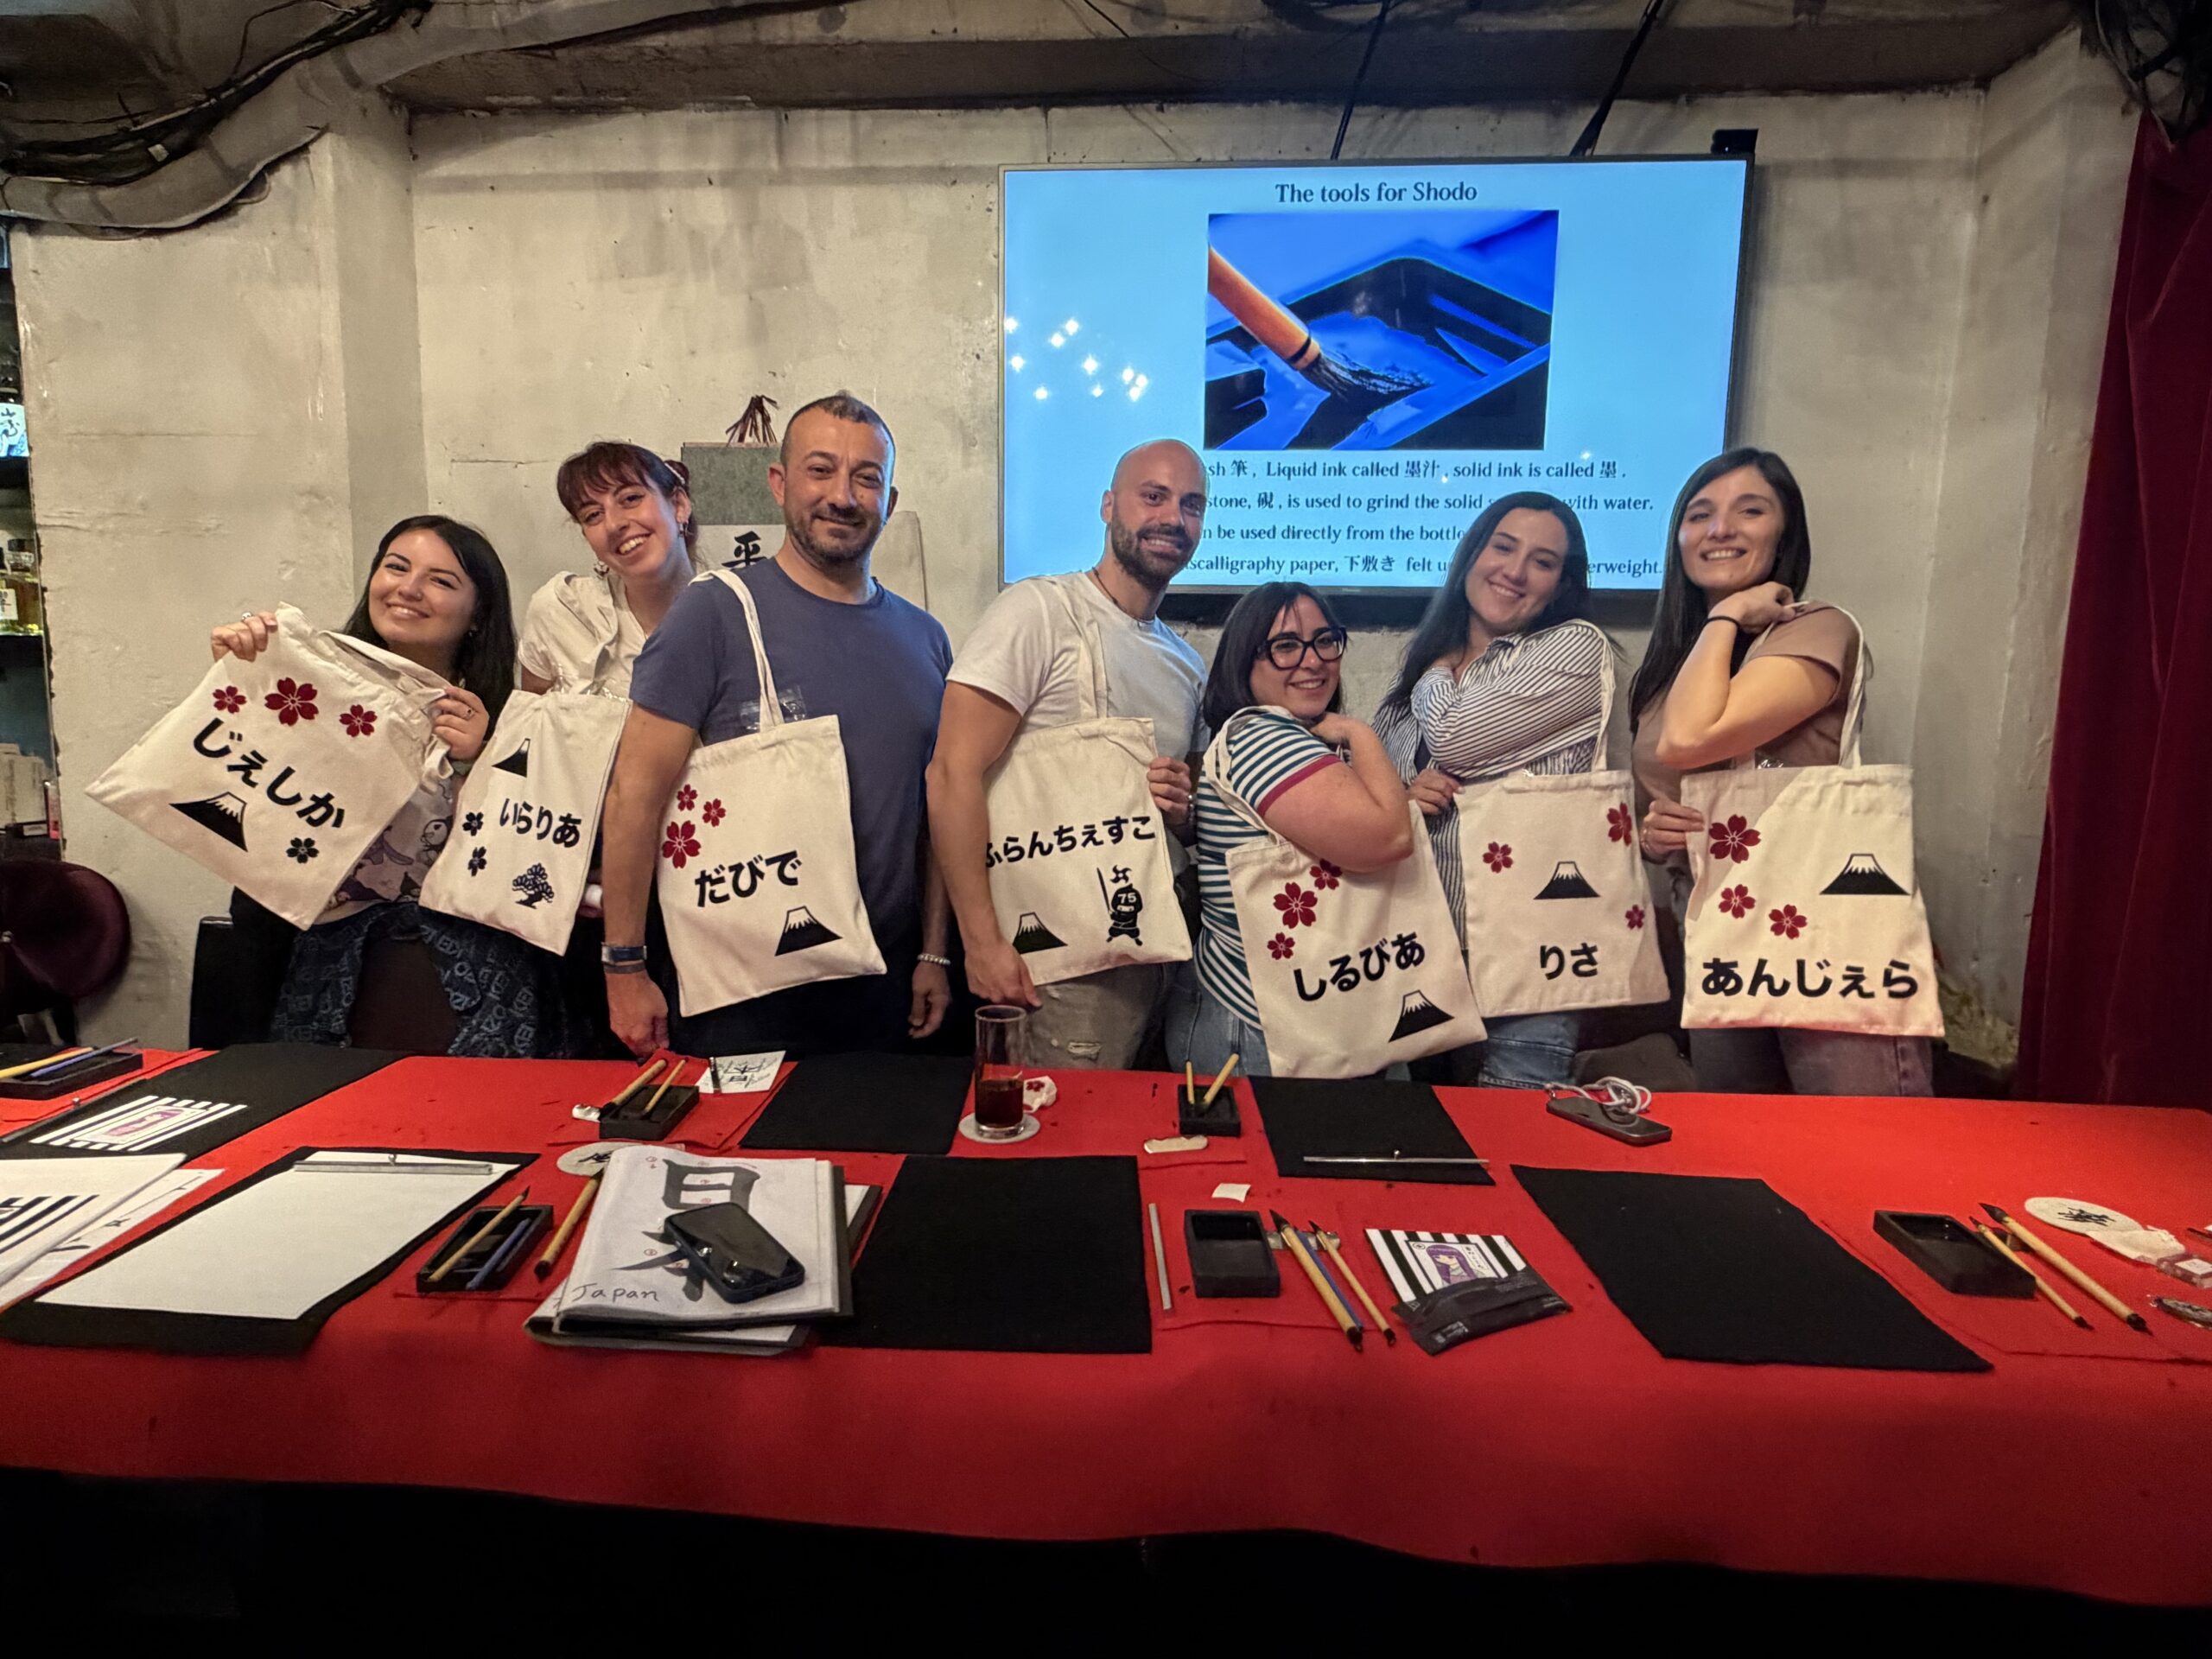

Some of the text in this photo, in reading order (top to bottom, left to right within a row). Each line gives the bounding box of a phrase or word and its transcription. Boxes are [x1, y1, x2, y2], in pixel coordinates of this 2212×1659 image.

[1274, 181, 1478, 203] The tools for Shodo
[1266, 461, 1318, 480] Liquid
[1322, 461, 1347, 477] ink
[1351, 461, 1400, 477] called
[1452, 461, 1492, 478] solid
[1497, 461, 1522, 478] ink
[1528, 461, 1541, 478] is
[1545, 461, 1594, 478] called
[1287, 494, 1301, 509] is
[1305, 493, 1342, 509] used
[1345, 495, 1363, 509] to
[1366, 493, 1410, 512] grind
[1414, 493, 1440, 509] the
[1444, 493, 1484, 510] solid
[1603, 495, 1655, 512] water.
[1217, 524, 1236, 540] be
[1240, 524, 1277, 540] used
[1281, 524, 1342, 543] directly
[1345, 524, 1385, 540] from
[1389, 524, 1414, 541] the
[1289, 558, 1339, 575] paper,
[1343, 554, 1396, 573] 下敷き
[1406, 556, 1433, 572] felt
[1587, 558, 1663, 577] erweight.
[193, 716, 346, 829] じぇしか
[499, 797, 582, 849] いらりあ
[694, 849, 804, 908] だびで
[1117, 892, 1137, 905] 75
[1293, 931, 1426, 1002] しるびあ
[1540, 942, 1599, 981] りさ
[1700, 957, 1919, 1001] あんじぇら
[571, 1281, 660, 1305] Japan
